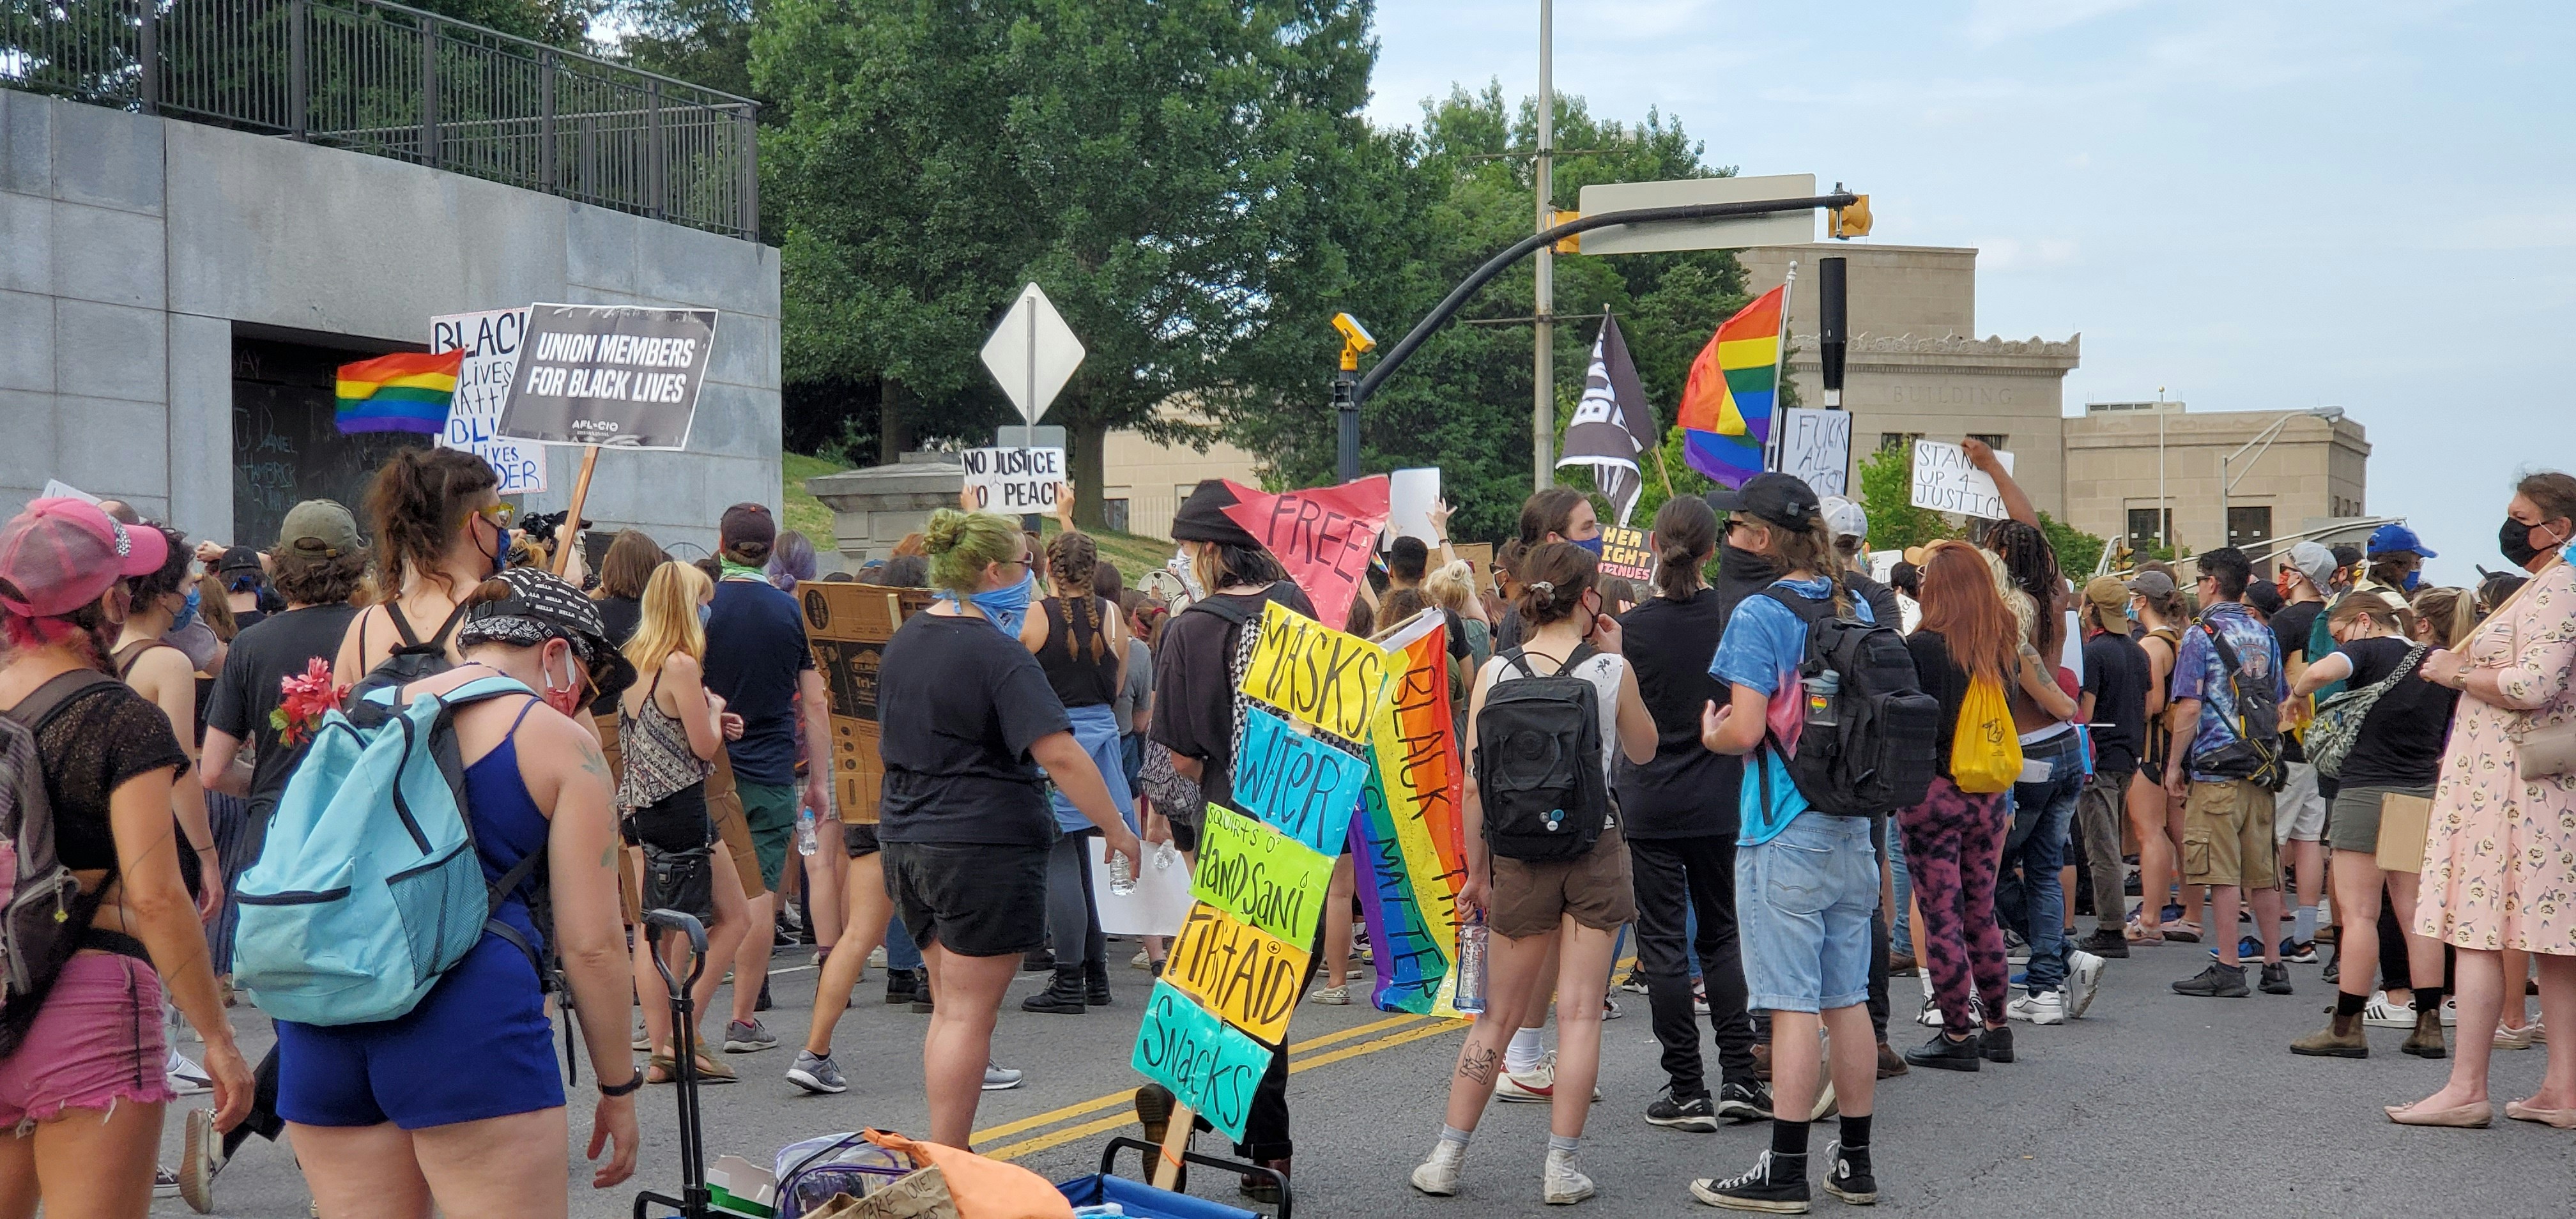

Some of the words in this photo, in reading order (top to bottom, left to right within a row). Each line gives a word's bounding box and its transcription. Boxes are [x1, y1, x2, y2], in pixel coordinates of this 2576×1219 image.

[537, 332, 598, 364] UNION
[597, 334, 696, 369] MEMBERS
[526, 366, 567, 397] FOR
[567, 369, 632, 401] BLACK
[632, 372, 687, 404] LIVES
[1893, 385, 2014, 405] BUILDING
[452, 417, 505, 444] BL
[572, 419, 618, 432] AFL-CIO
[1797, 414, 1847, 452] FUCK
[963, 450, 987, 476] NO
[994, 449, 1058, 476] JUSTICE
[1798, 445, 1831, 472] ALL
[1919, 443, 1978, 471] STAN
[1919, 469, 1945, 486] UP
[1958, 473, 1980, 491] 4
[1267, 494, 1370, 583] FREE
[1602, 526, 1643, 548] HER
[1601, 544, 1651, 568] IGHT
[1597, 562, 1651, 581] TINUES
[1243, 609, 1379, 739] MASKS
[855, 1190, 898, 1219] TAKE
